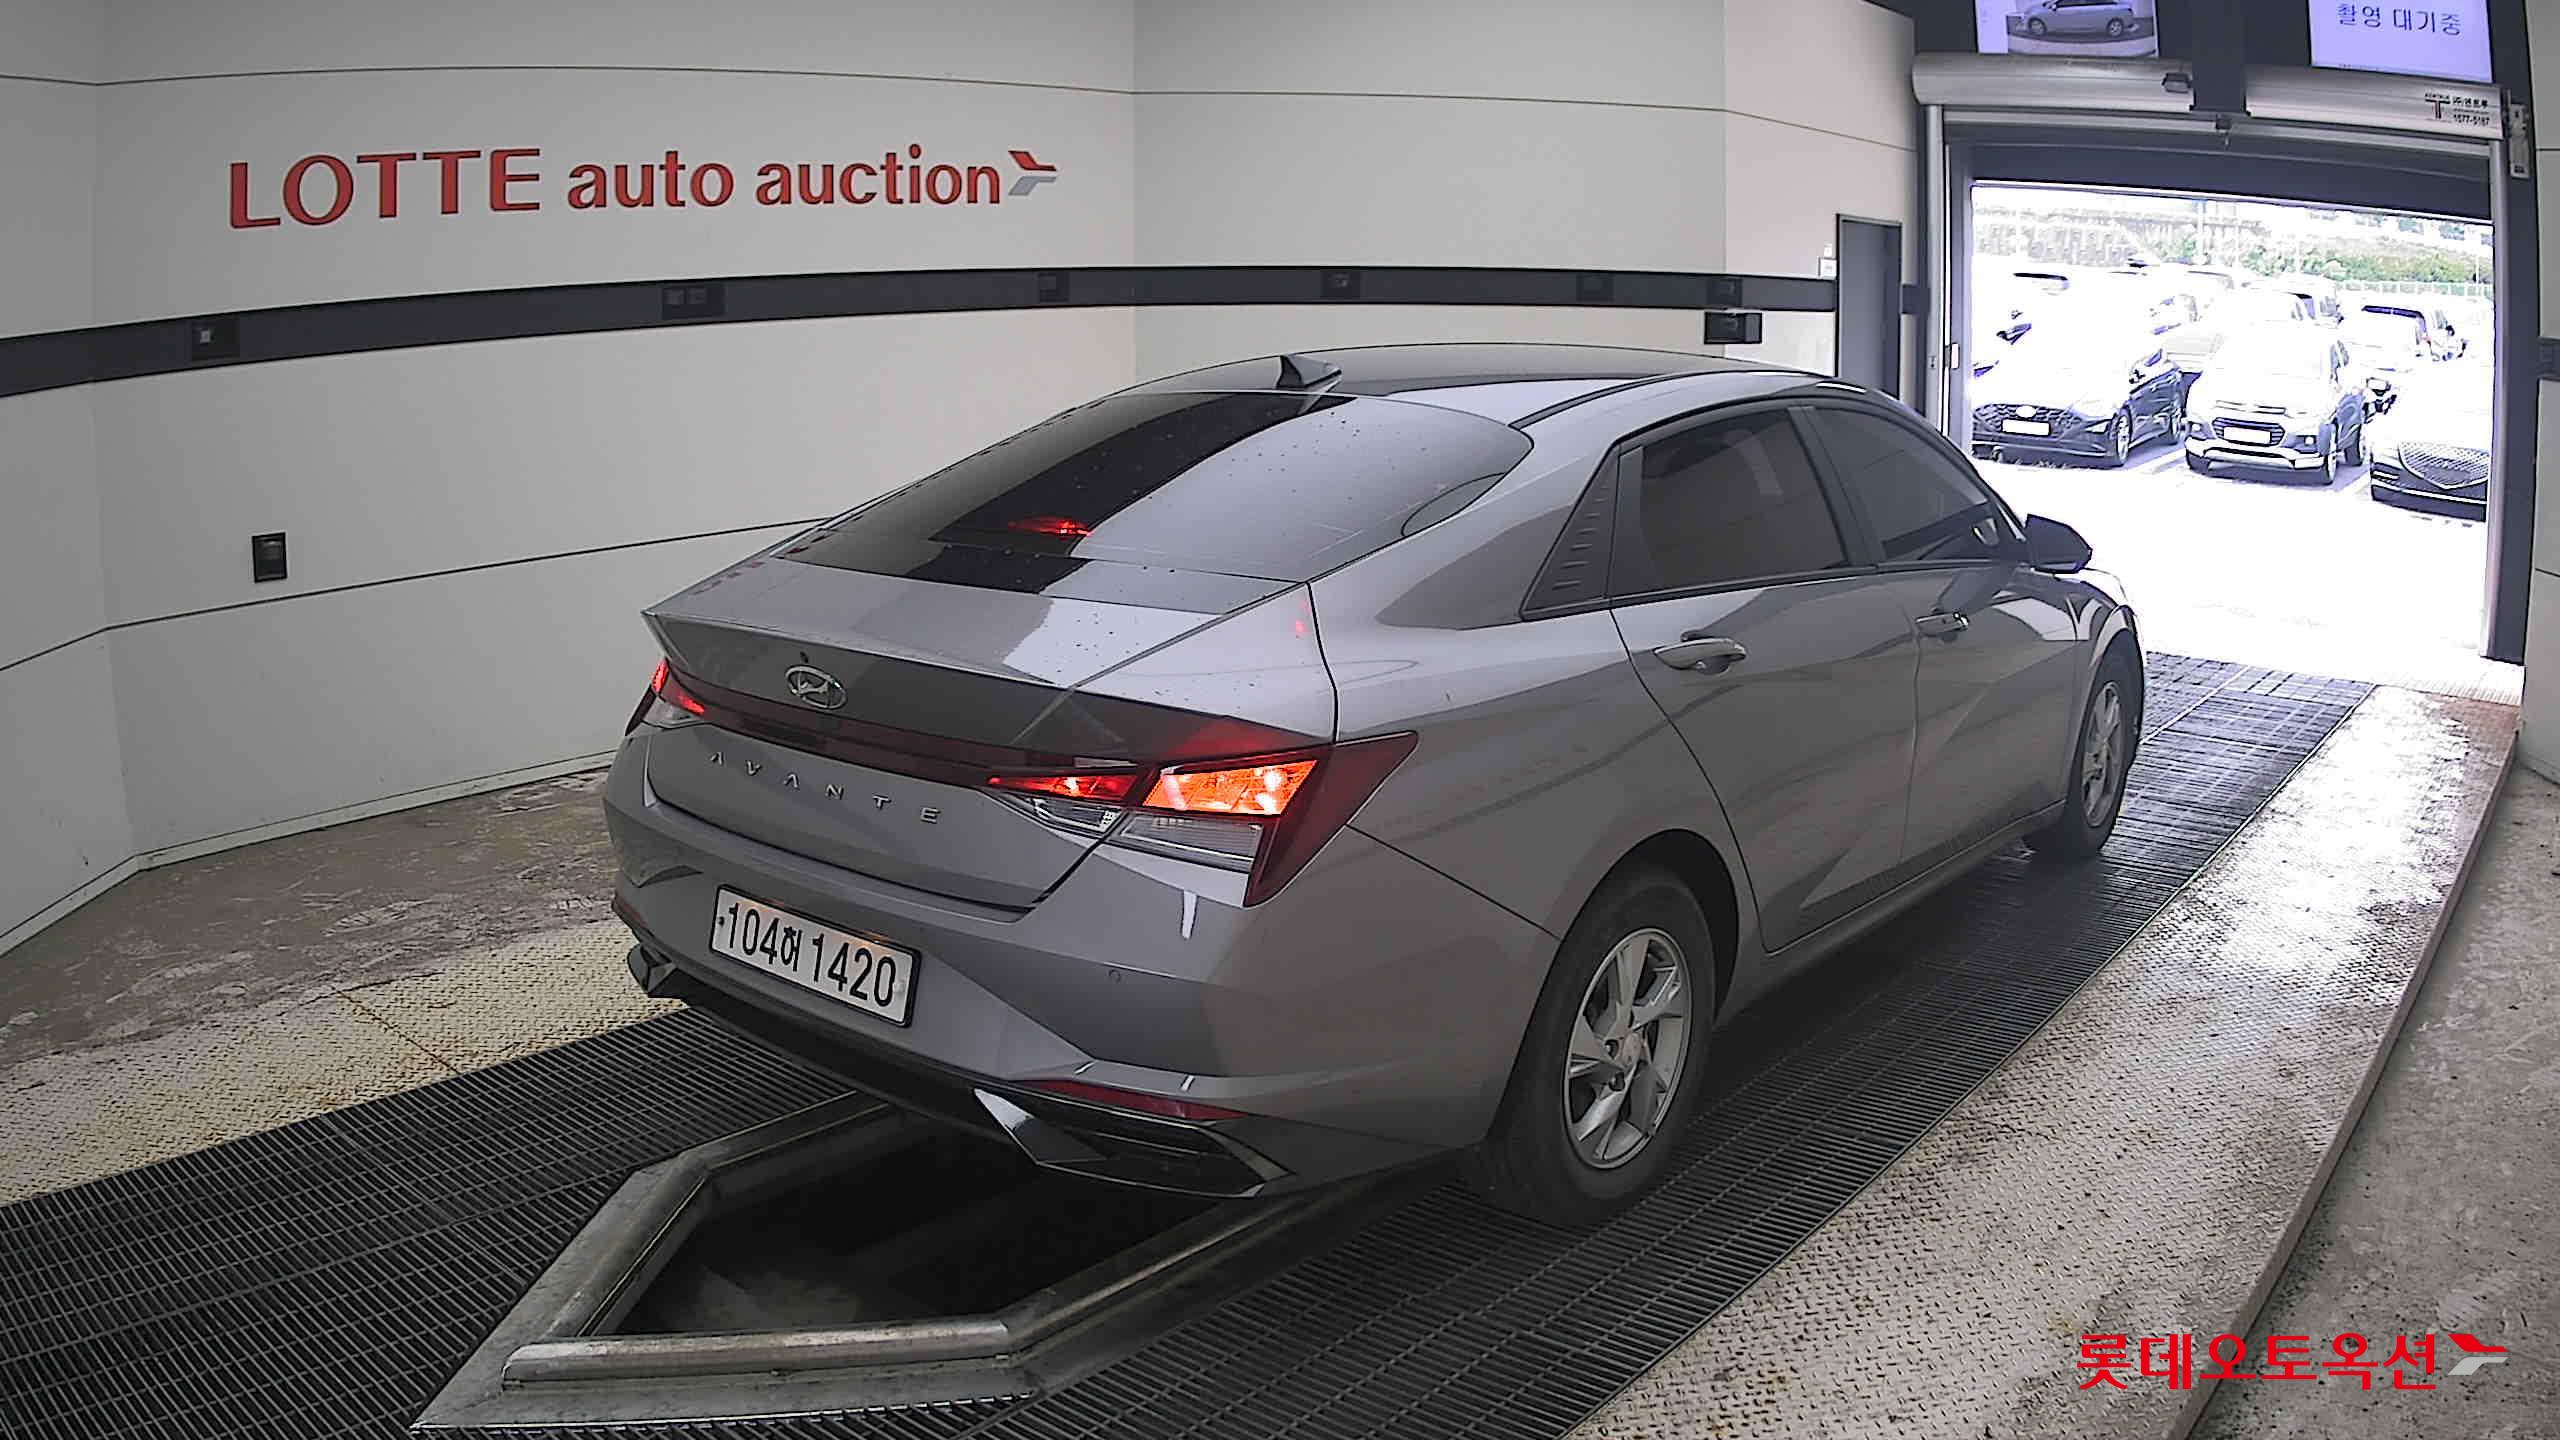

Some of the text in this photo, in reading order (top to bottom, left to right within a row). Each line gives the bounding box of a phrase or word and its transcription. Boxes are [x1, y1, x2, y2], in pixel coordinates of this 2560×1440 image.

[2337, 3, 2462, 36] 촬영 대기중
[229, 144, 1001, 229] LOTTE auto auction
[710, 751, 942, 824] AVANTE
[812, 933, 897, 1007] 1420
